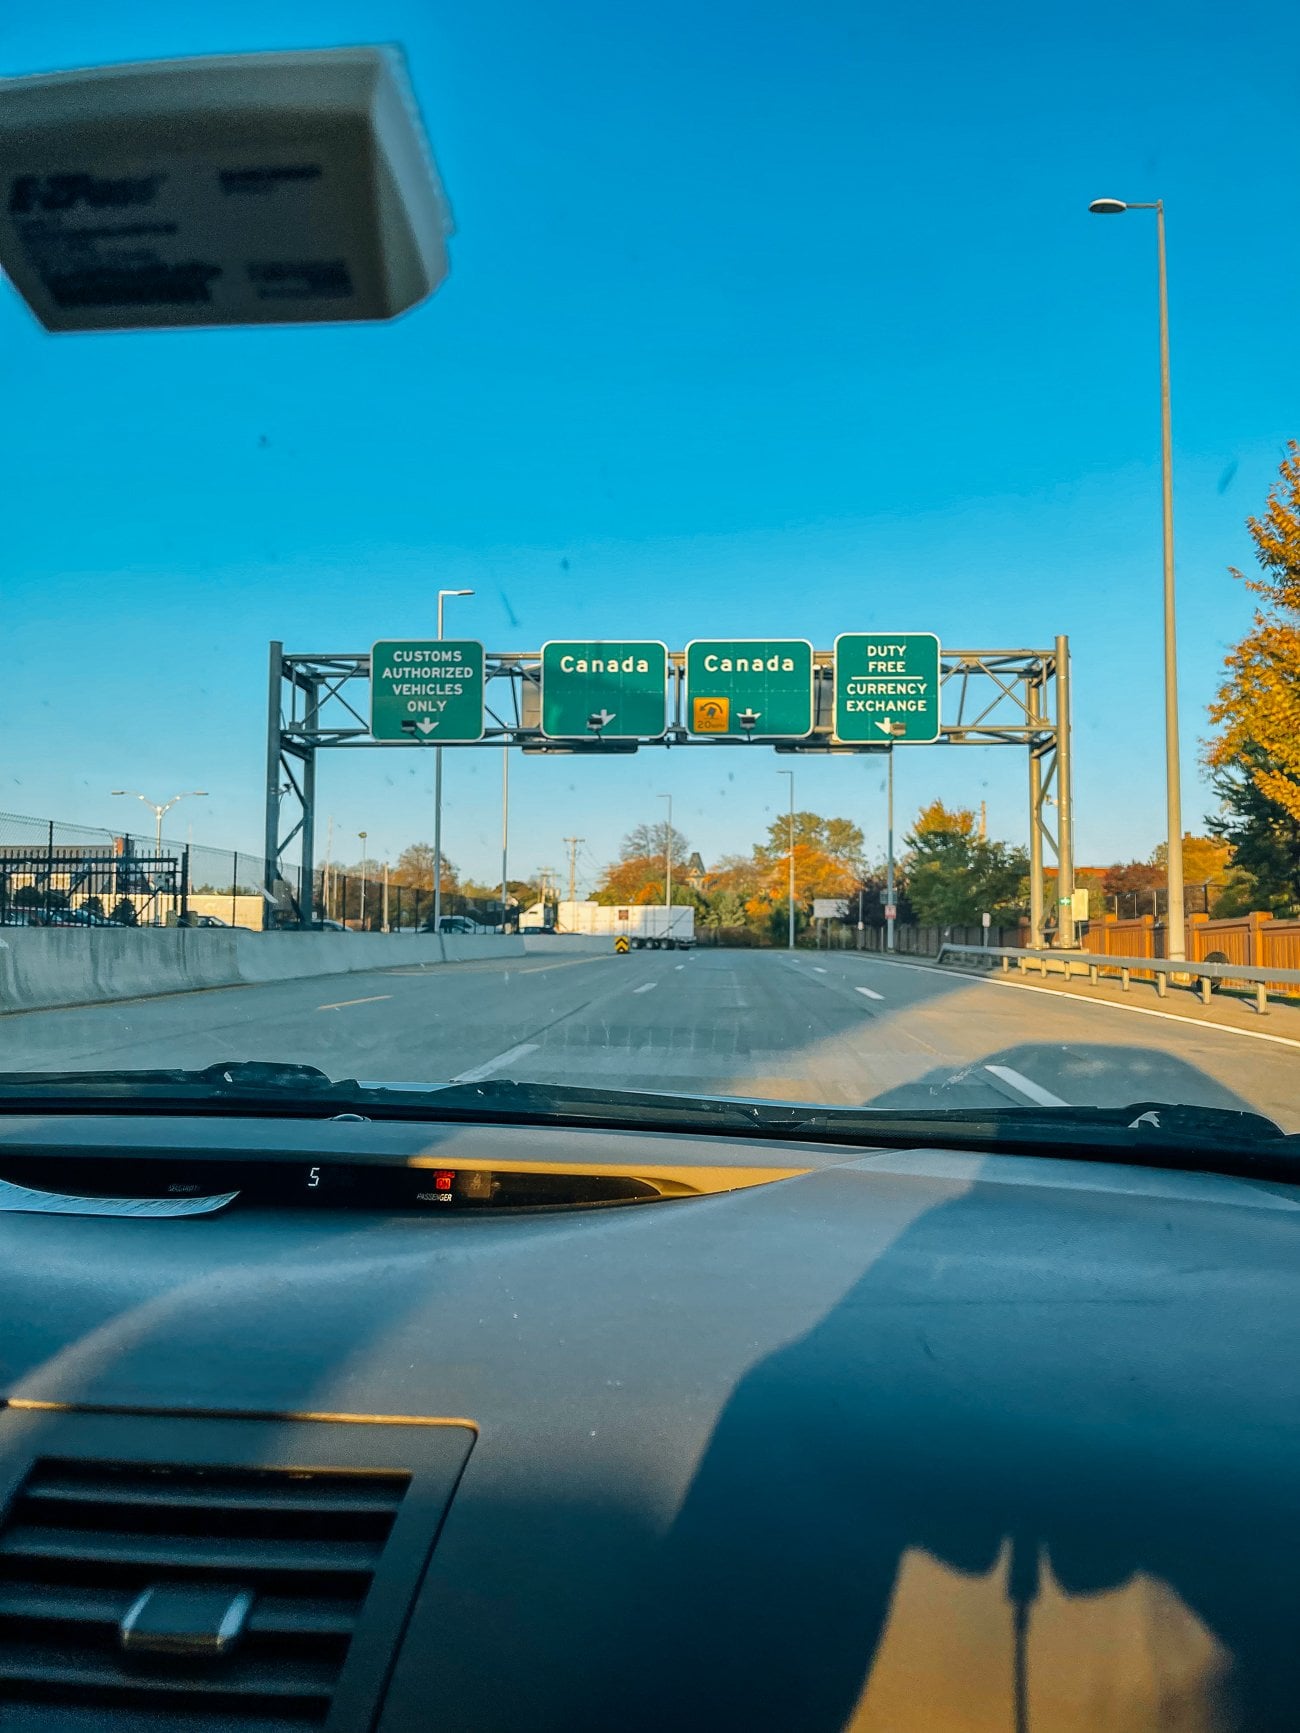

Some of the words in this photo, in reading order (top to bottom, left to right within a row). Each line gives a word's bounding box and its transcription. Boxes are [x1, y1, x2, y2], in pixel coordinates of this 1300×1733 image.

[393, 651, 462, 662] CUSTOMS
[867, 645, 907, 657] DUTY
[560, 656, 649, 673] Canada
[704, 655, 794, 672] Canada
[868, 661, 906, 673] FREE
[382, 667, 474, 679] AUTHORIZED
[392, 684, 463, 695] VEHICLES
[846, 683, 928, 695] CURRENCY
[407, 701, 447, 712] ONLY
[846, 700, 927, 712] EXCHANGE
[697, 720, 712, 729] 20
[307, 1167, 320, 1187] 5
